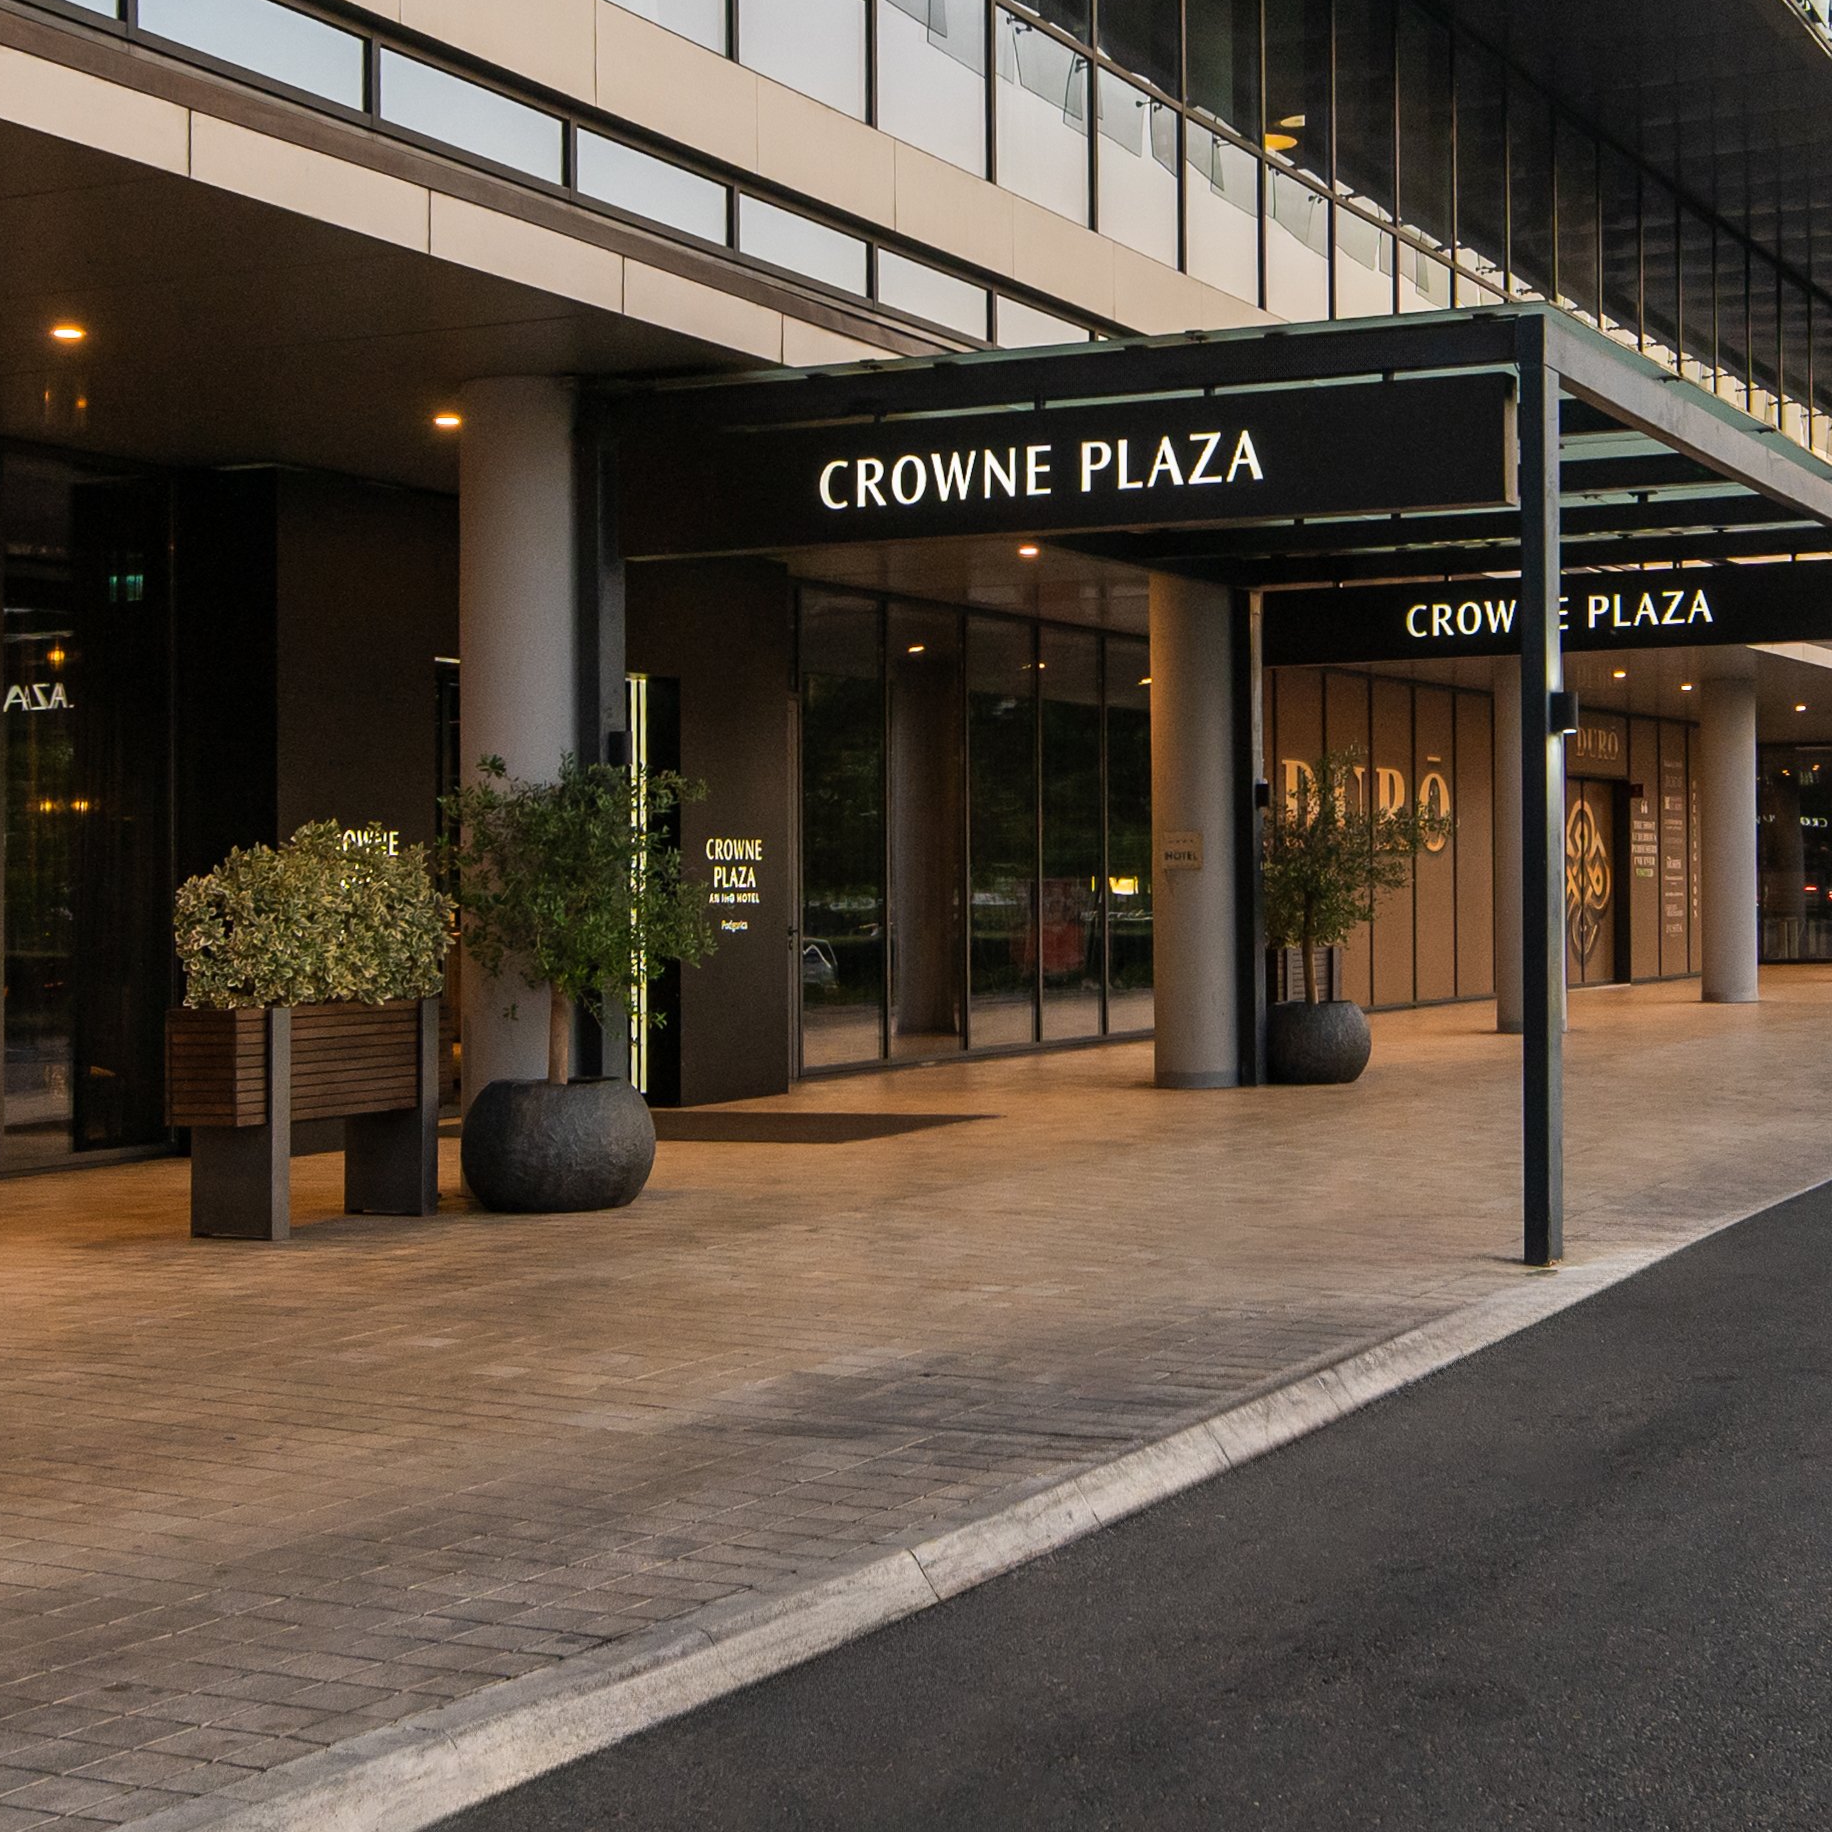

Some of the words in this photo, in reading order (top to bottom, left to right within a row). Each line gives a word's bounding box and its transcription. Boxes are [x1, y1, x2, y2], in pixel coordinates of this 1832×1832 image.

[818, 444, 1052, 510] CROWNE
[1080, 429, 1264, 493] PLAZA
[1406, 597, 1569, 638] CROWE
[1587, 588, 1714, 629] PLAZA
[706, 838, 763, 861] CROWNE
[1164, 851, 1198, 861] HOTEL
[713, 866, 756, 888] PLAZA
[736, 892, 760, 903] HOTEL
